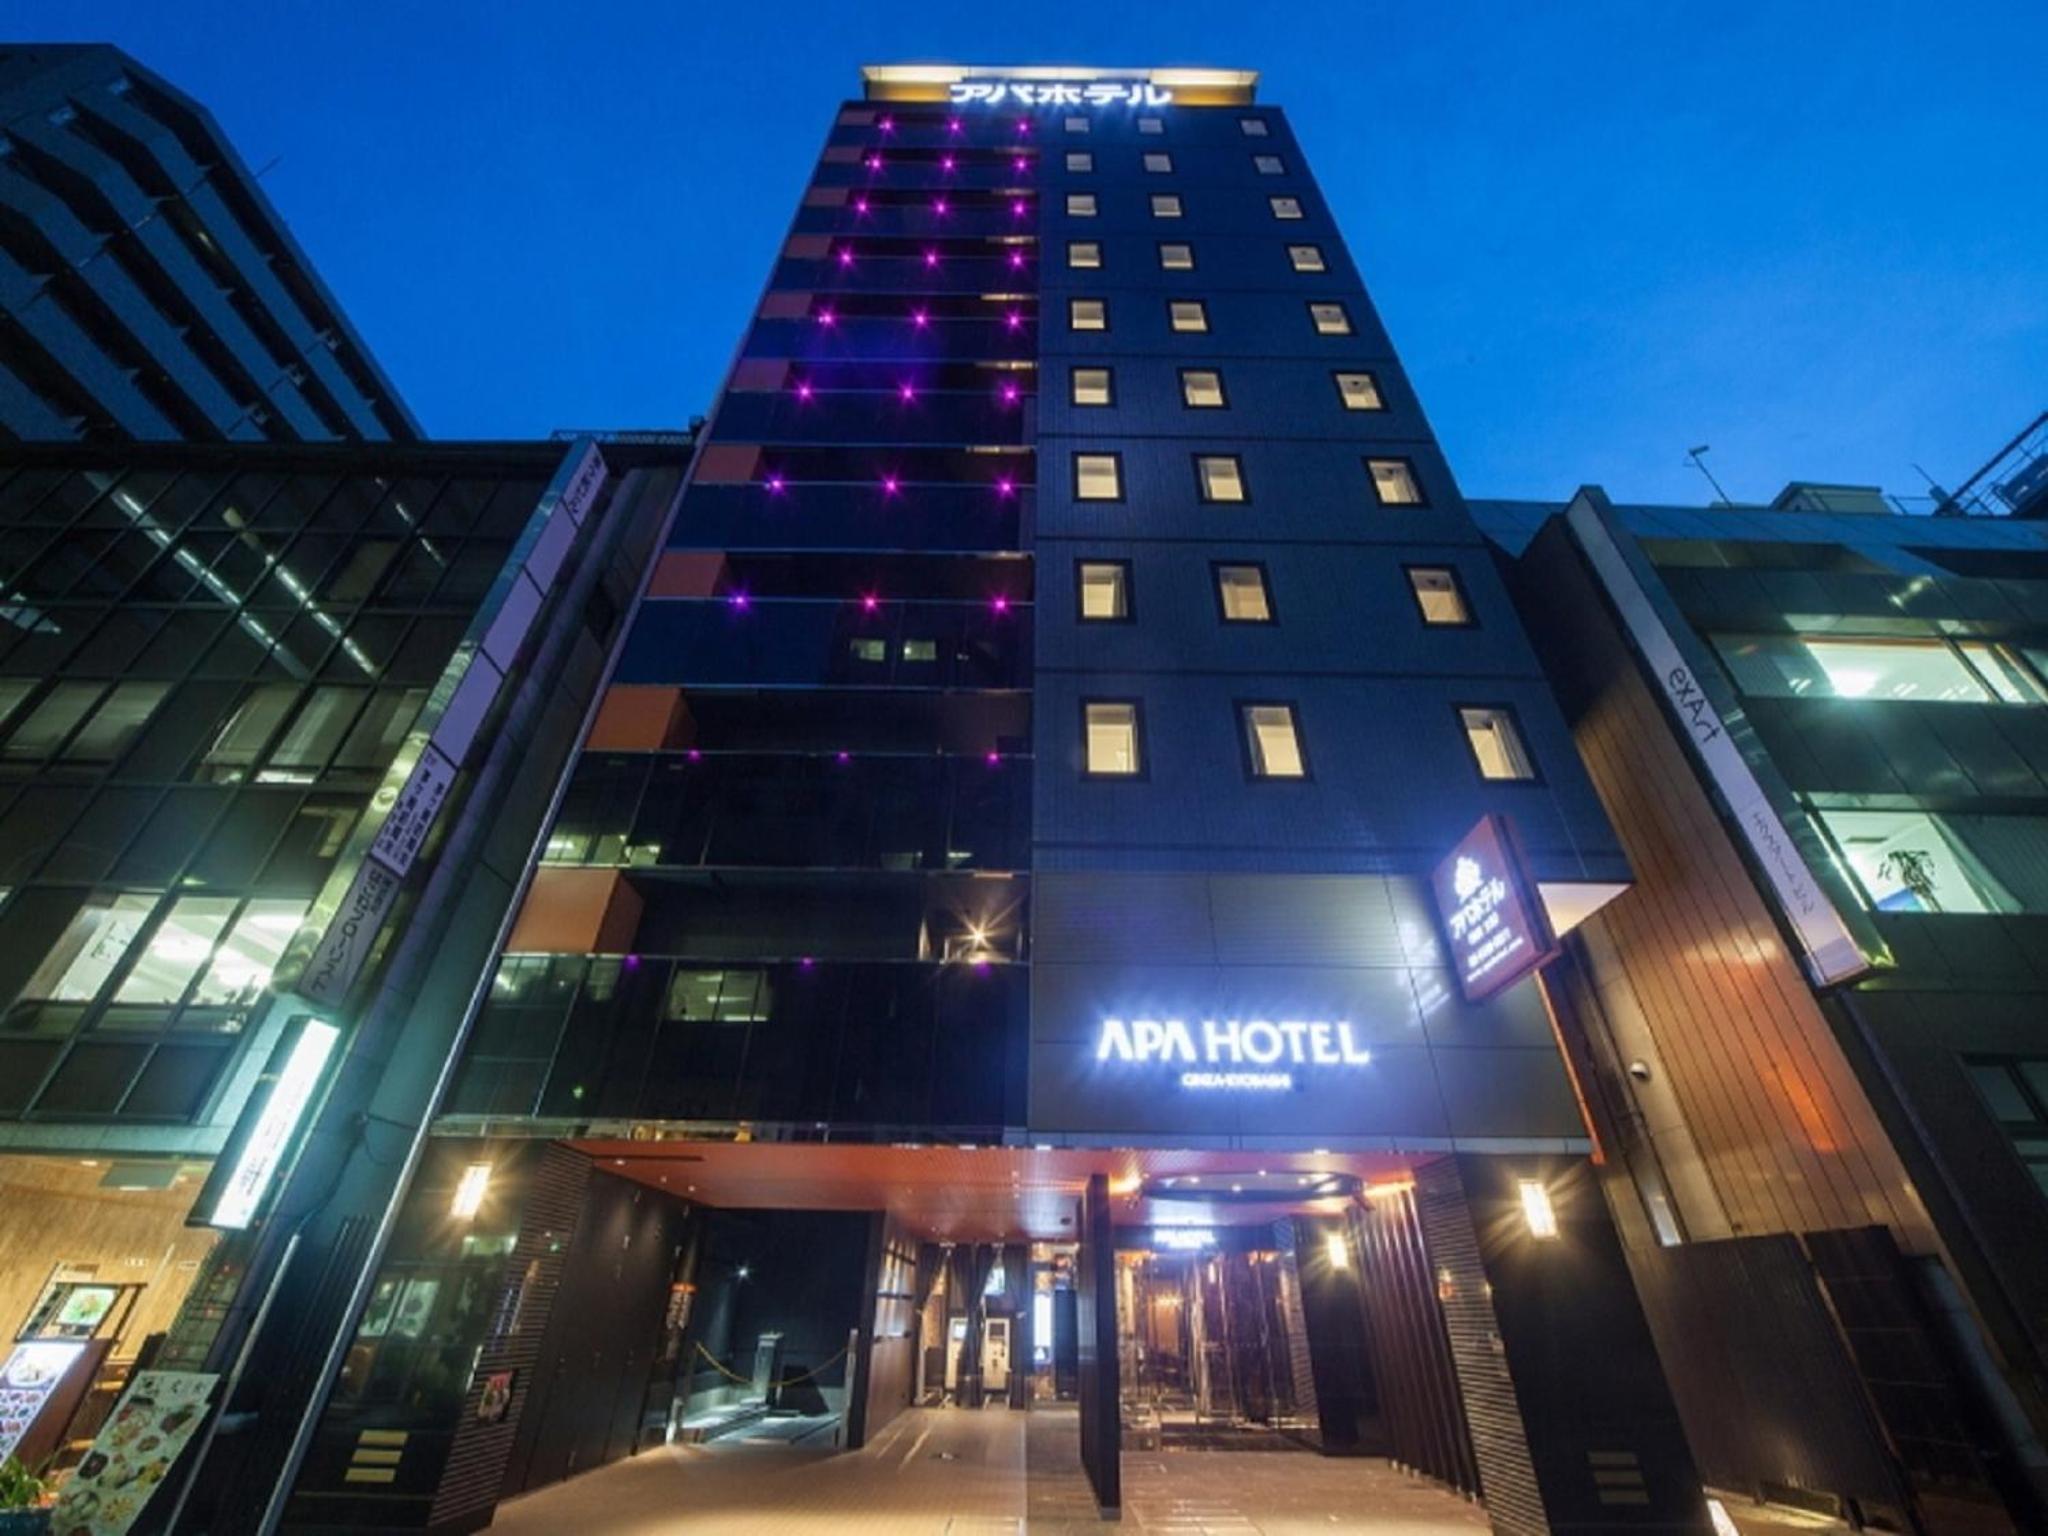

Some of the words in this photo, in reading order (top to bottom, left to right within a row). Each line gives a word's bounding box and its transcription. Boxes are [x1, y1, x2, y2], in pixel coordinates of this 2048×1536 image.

[950, 83, 1172, 105] アパホテル
[1669, 668, 1720, 743] exArt
[1098, 1018, 1197, 1062] APA
[1202, 1020, 1371, 1064] HOTEL
